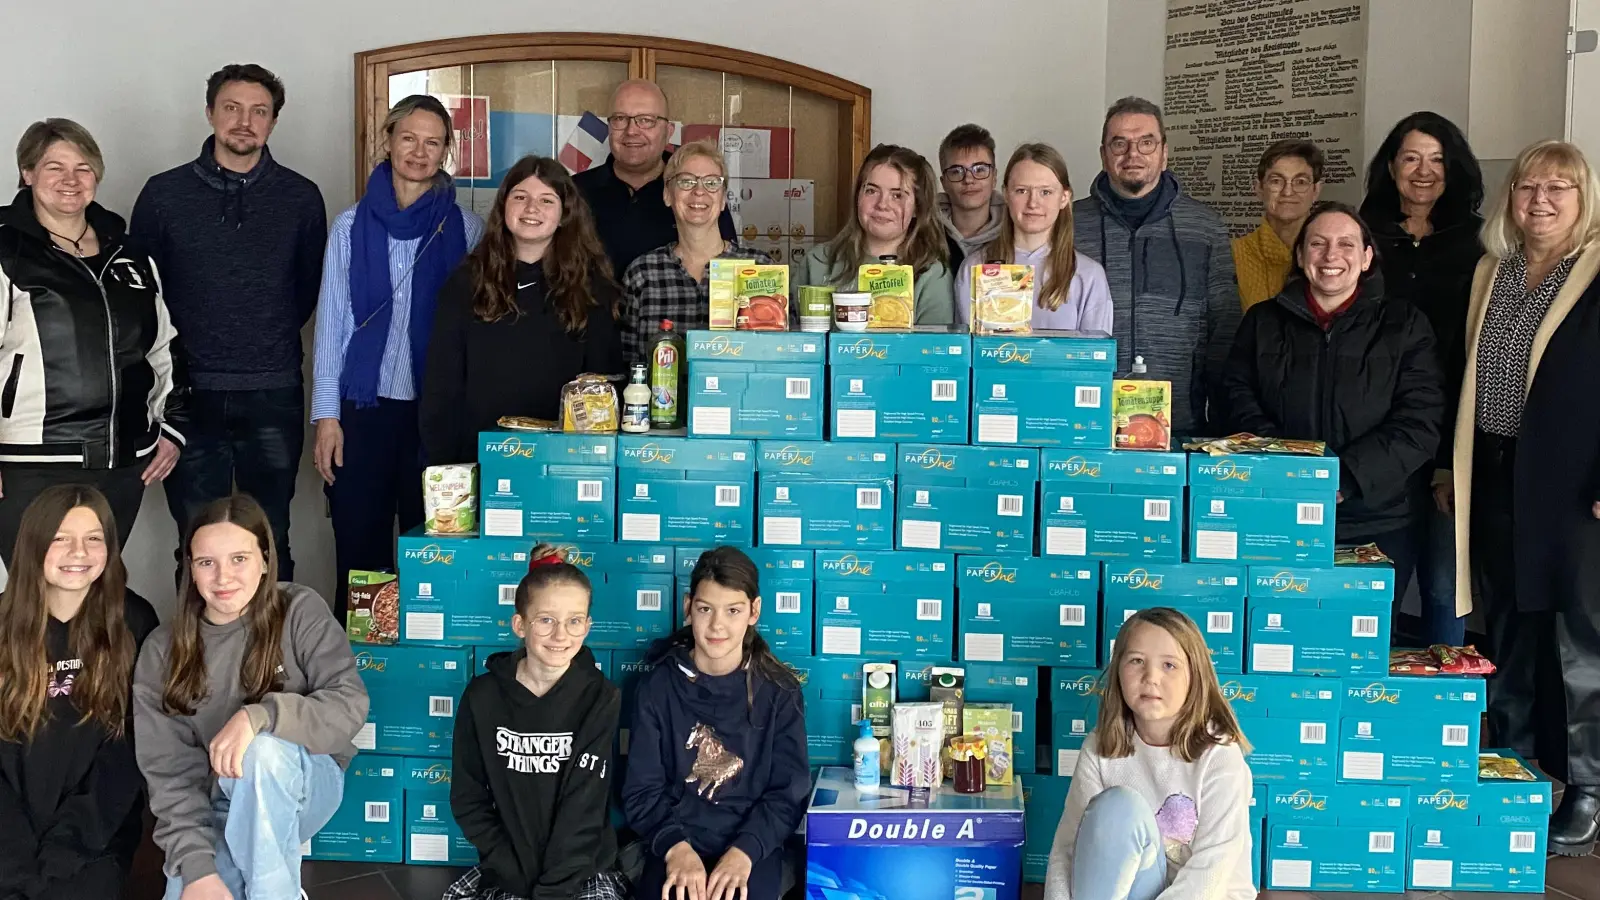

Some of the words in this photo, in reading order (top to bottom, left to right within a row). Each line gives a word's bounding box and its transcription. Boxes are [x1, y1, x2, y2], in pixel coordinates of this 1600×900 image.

[744, 278, 777, 290] Tomaten
[869, 277, 904, 291] Kartoffel
[694, 342, 724, 351] PAPER
[838, 345, 868, 354] PAPER
[657, 350, 674, 364] Pril
[981, 349, 1011, 358] PAPER
[485, 444, 515, 453] PAPER
[624, 449, 653, 458] PAPER
[764, 452, 793, 460] PAPER
[905, 455, 934, 464] PAPER
[1049, 462, 1079, 471] PAPER
[1198, 466, 1229, 475] PAPER
[405, 550, 434, 559] PAPER
[823, 562, 852, 570] PAPER
[966, 569, 996, 577] PAPER
[1111, 575, 1141, 584] PAPER
[1256, 578, 1287, 587] PAPER
[621, 664, 650, 673] PAPER
[1060, 682, 1090, 691] PAPER
[1348, 689, 1379, 698] PAPER
[868, 700, 889, 708] albi
[496, 730, 573, 758] STRANGER
[507, 752, 560, 773] THINGS
[411, 770, 440, 779] PAPER
[1275, 796, 1306, 805] PAPER
[1417, 797, 1448, 805] PAPER
[847, 818, 946, 839] Double
